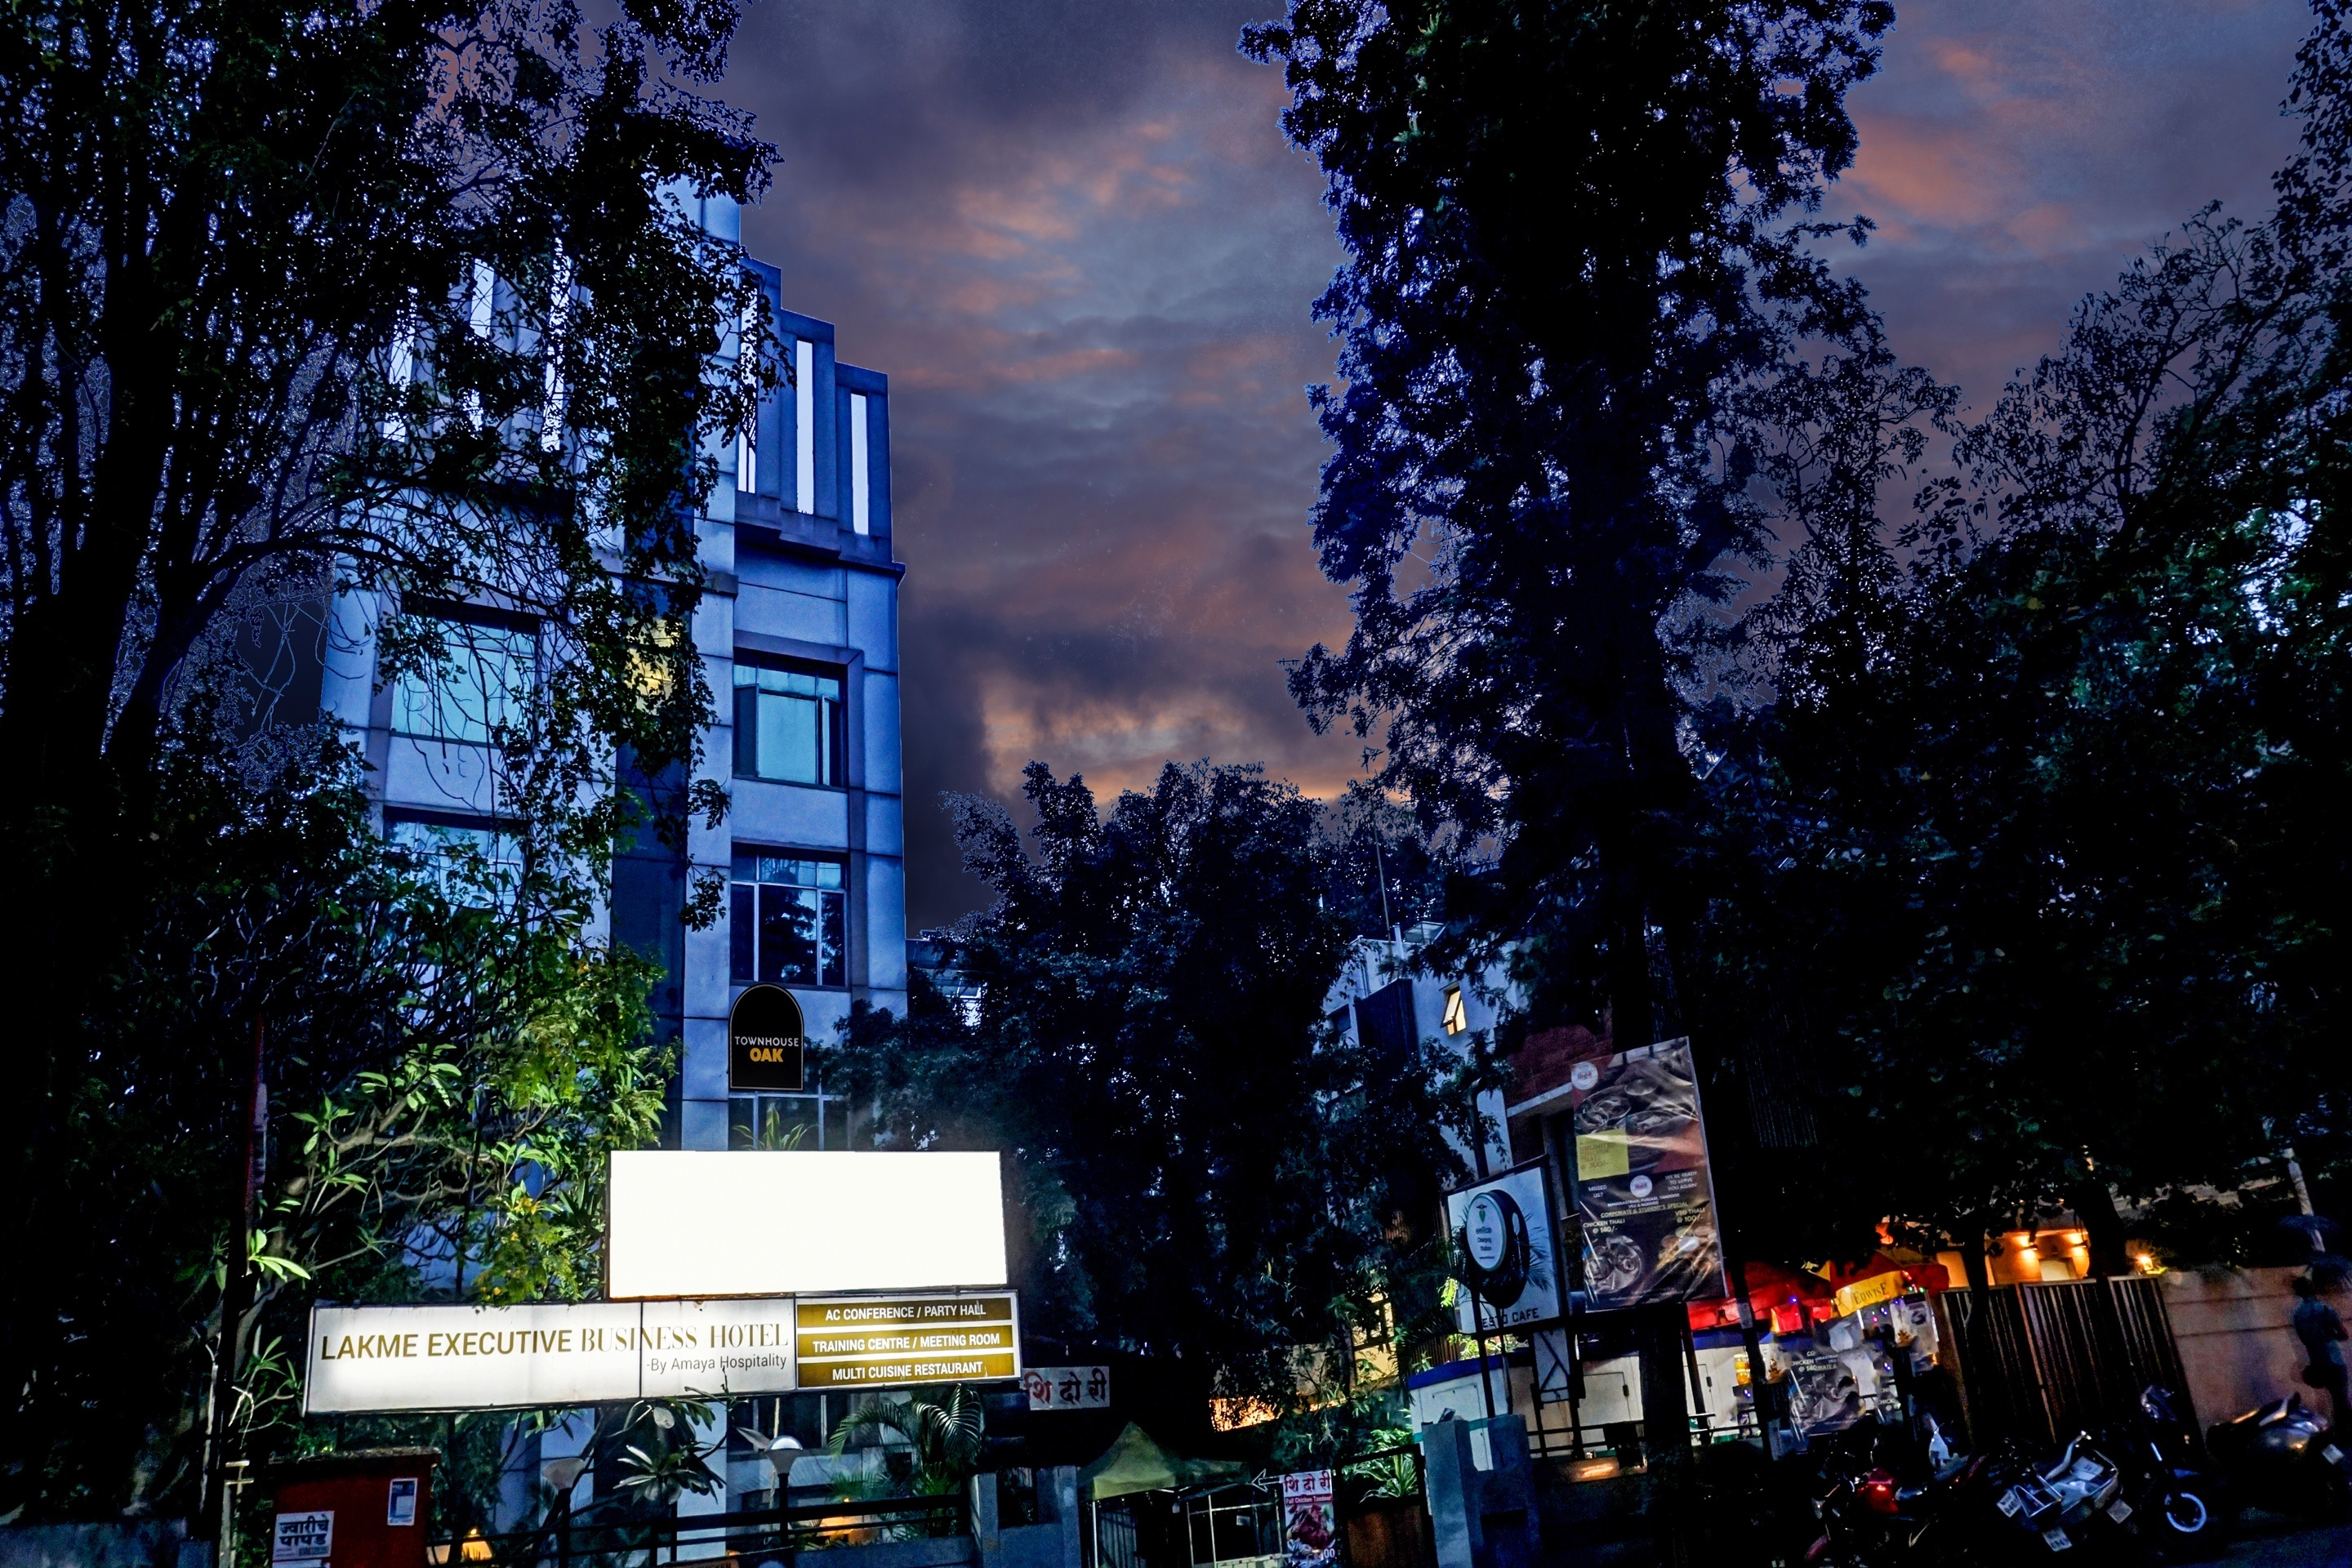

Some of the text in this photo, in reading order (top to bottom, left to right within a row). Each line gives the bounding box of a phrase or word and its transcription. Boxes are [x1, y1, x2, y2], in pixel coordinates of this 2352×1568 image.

[735, 1036, 799, 1047] TOWNHOUSE
[750, 1048, 783, 1062] OAK
[1601, 1209, 1632, 1218] CORPORATE
[1583, 1220, 1608, 1228] CHICKEN
[1852, 1282, 1886, 1304] EDWISE
[825, 1308, 840, 1321] AC
[843, 1305, 914, 1321] CONFERENCE
[924, 1303, 957, 1317] PARTY
[960, 1302, 986, 1316] HALL
[1512, 1308, 1539, 1322] CAFE
[321, 1323, 788, 1361] LAKME EXECUTIVE BUSINESS HOTEL
[813, 1338, 866, 1353] TRAINING
[867, 1336, 911, 1352] CENTRE
[920, 1334, 967, 1348] MEETING
[969, 1332, 1000, 1347] ROOM
[670, 1356, 715, 1373] Amaya
[720, 1353, 787, 1372] Hospitality
[832, 1361, 983, 1380] MULTI CUISINE RESTAURANT
[279, 1534, 327, 1547] पापड
